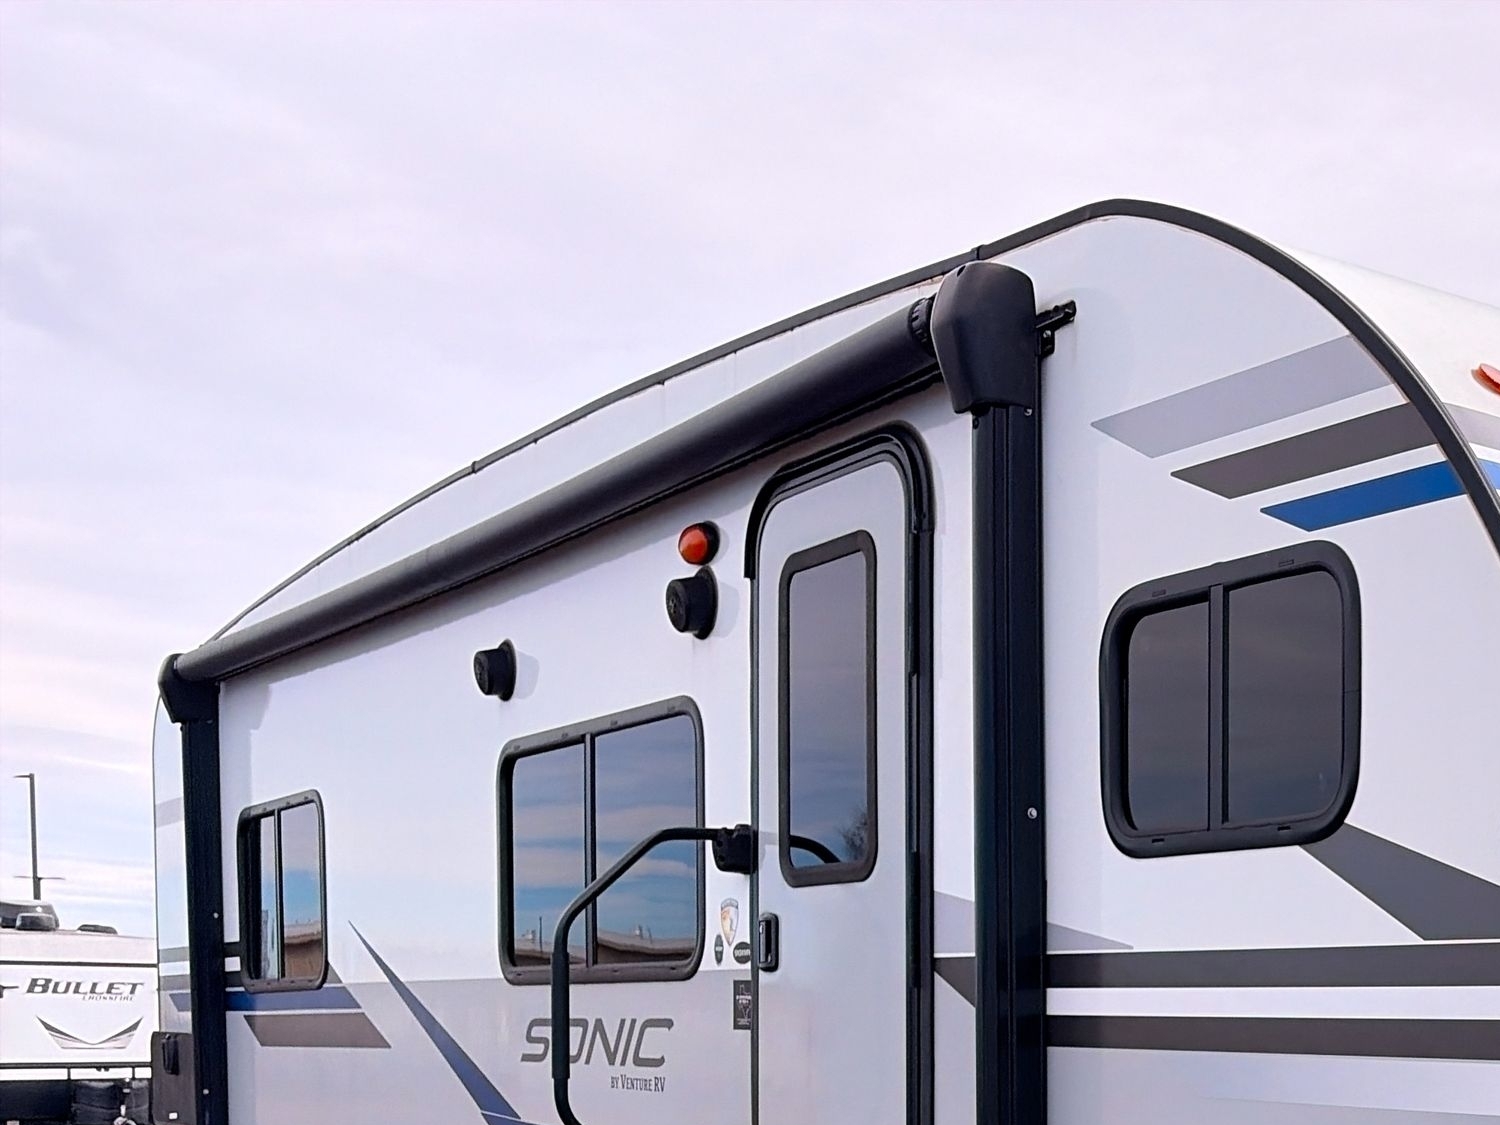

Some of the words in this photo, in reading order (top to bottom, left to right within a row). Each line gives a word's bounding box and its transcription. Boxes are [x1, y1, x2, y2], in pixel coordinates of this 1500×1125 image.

[26, 977, 145, 995] BULLET
[610, 1076, 619, 1089] BY
[620, 1074, 653, 1092] VENTURE
[653, 1076, 666, 1093] RV
